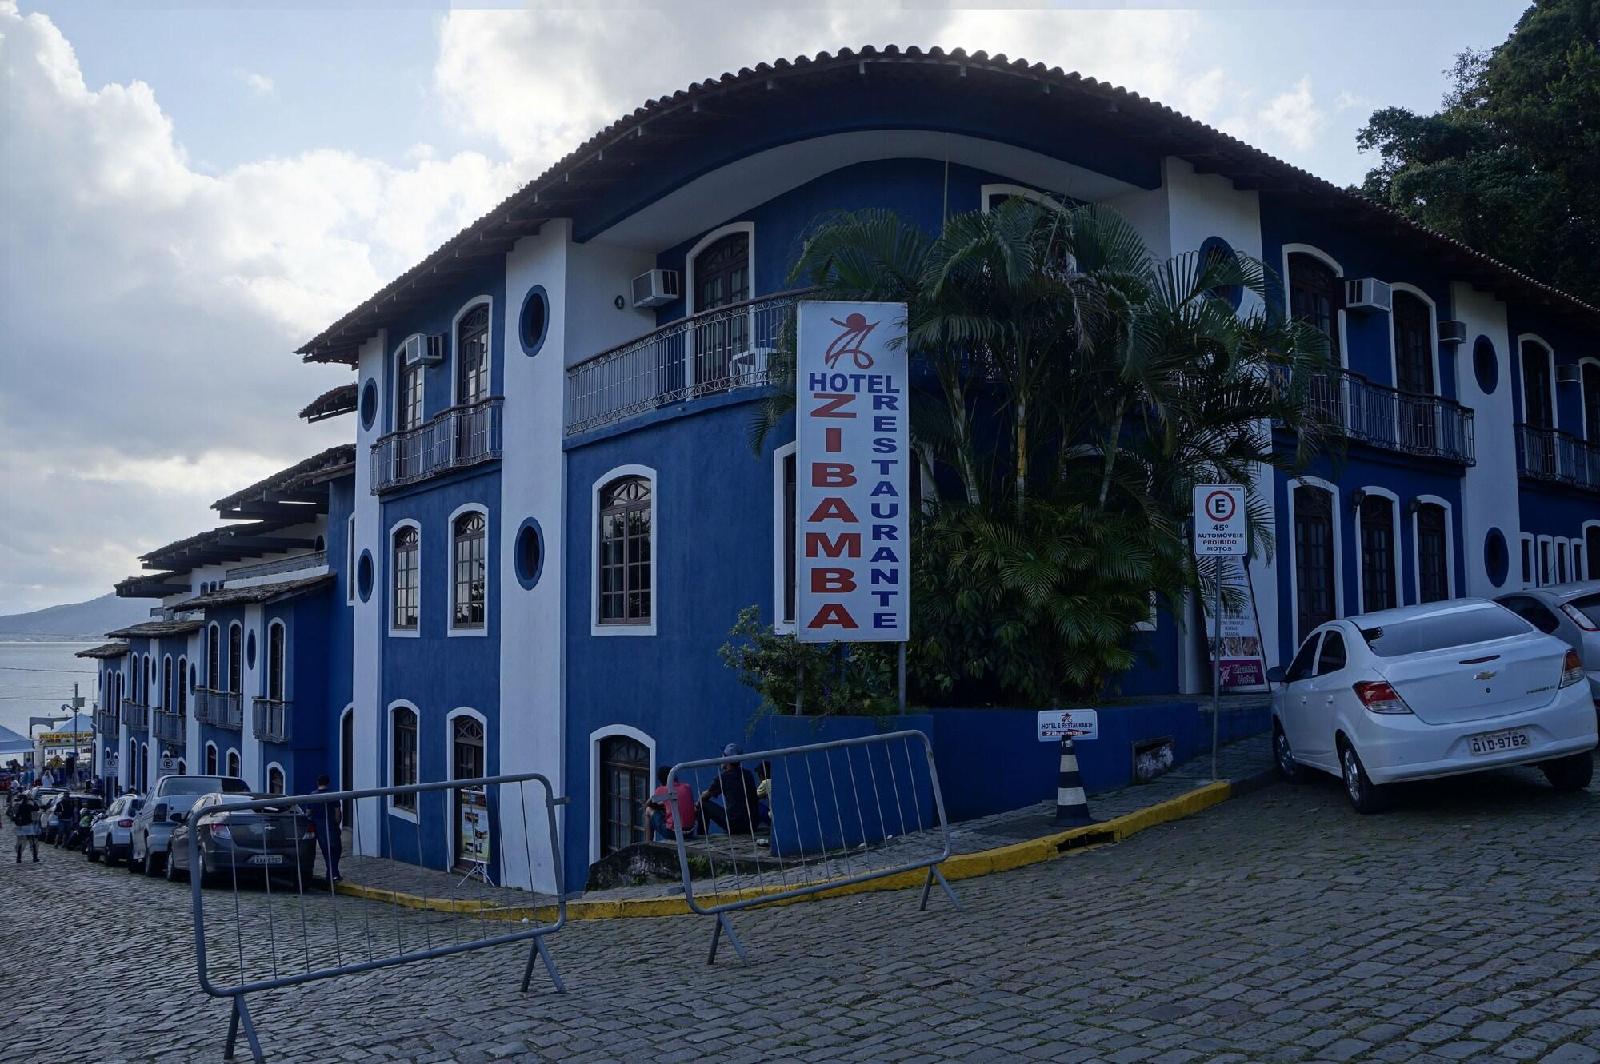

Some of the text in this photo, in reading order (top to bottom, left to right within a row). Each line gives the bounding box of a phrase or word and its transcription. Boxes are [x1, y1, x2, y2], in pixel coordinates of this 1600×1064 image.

[809, 372, 900, 394] HOTEL
[805, 393, 861, 629] ZIBAMBA
[869, 395, 899, 629] RESTAURANTE
[1215, 499, 1226, 514] E
